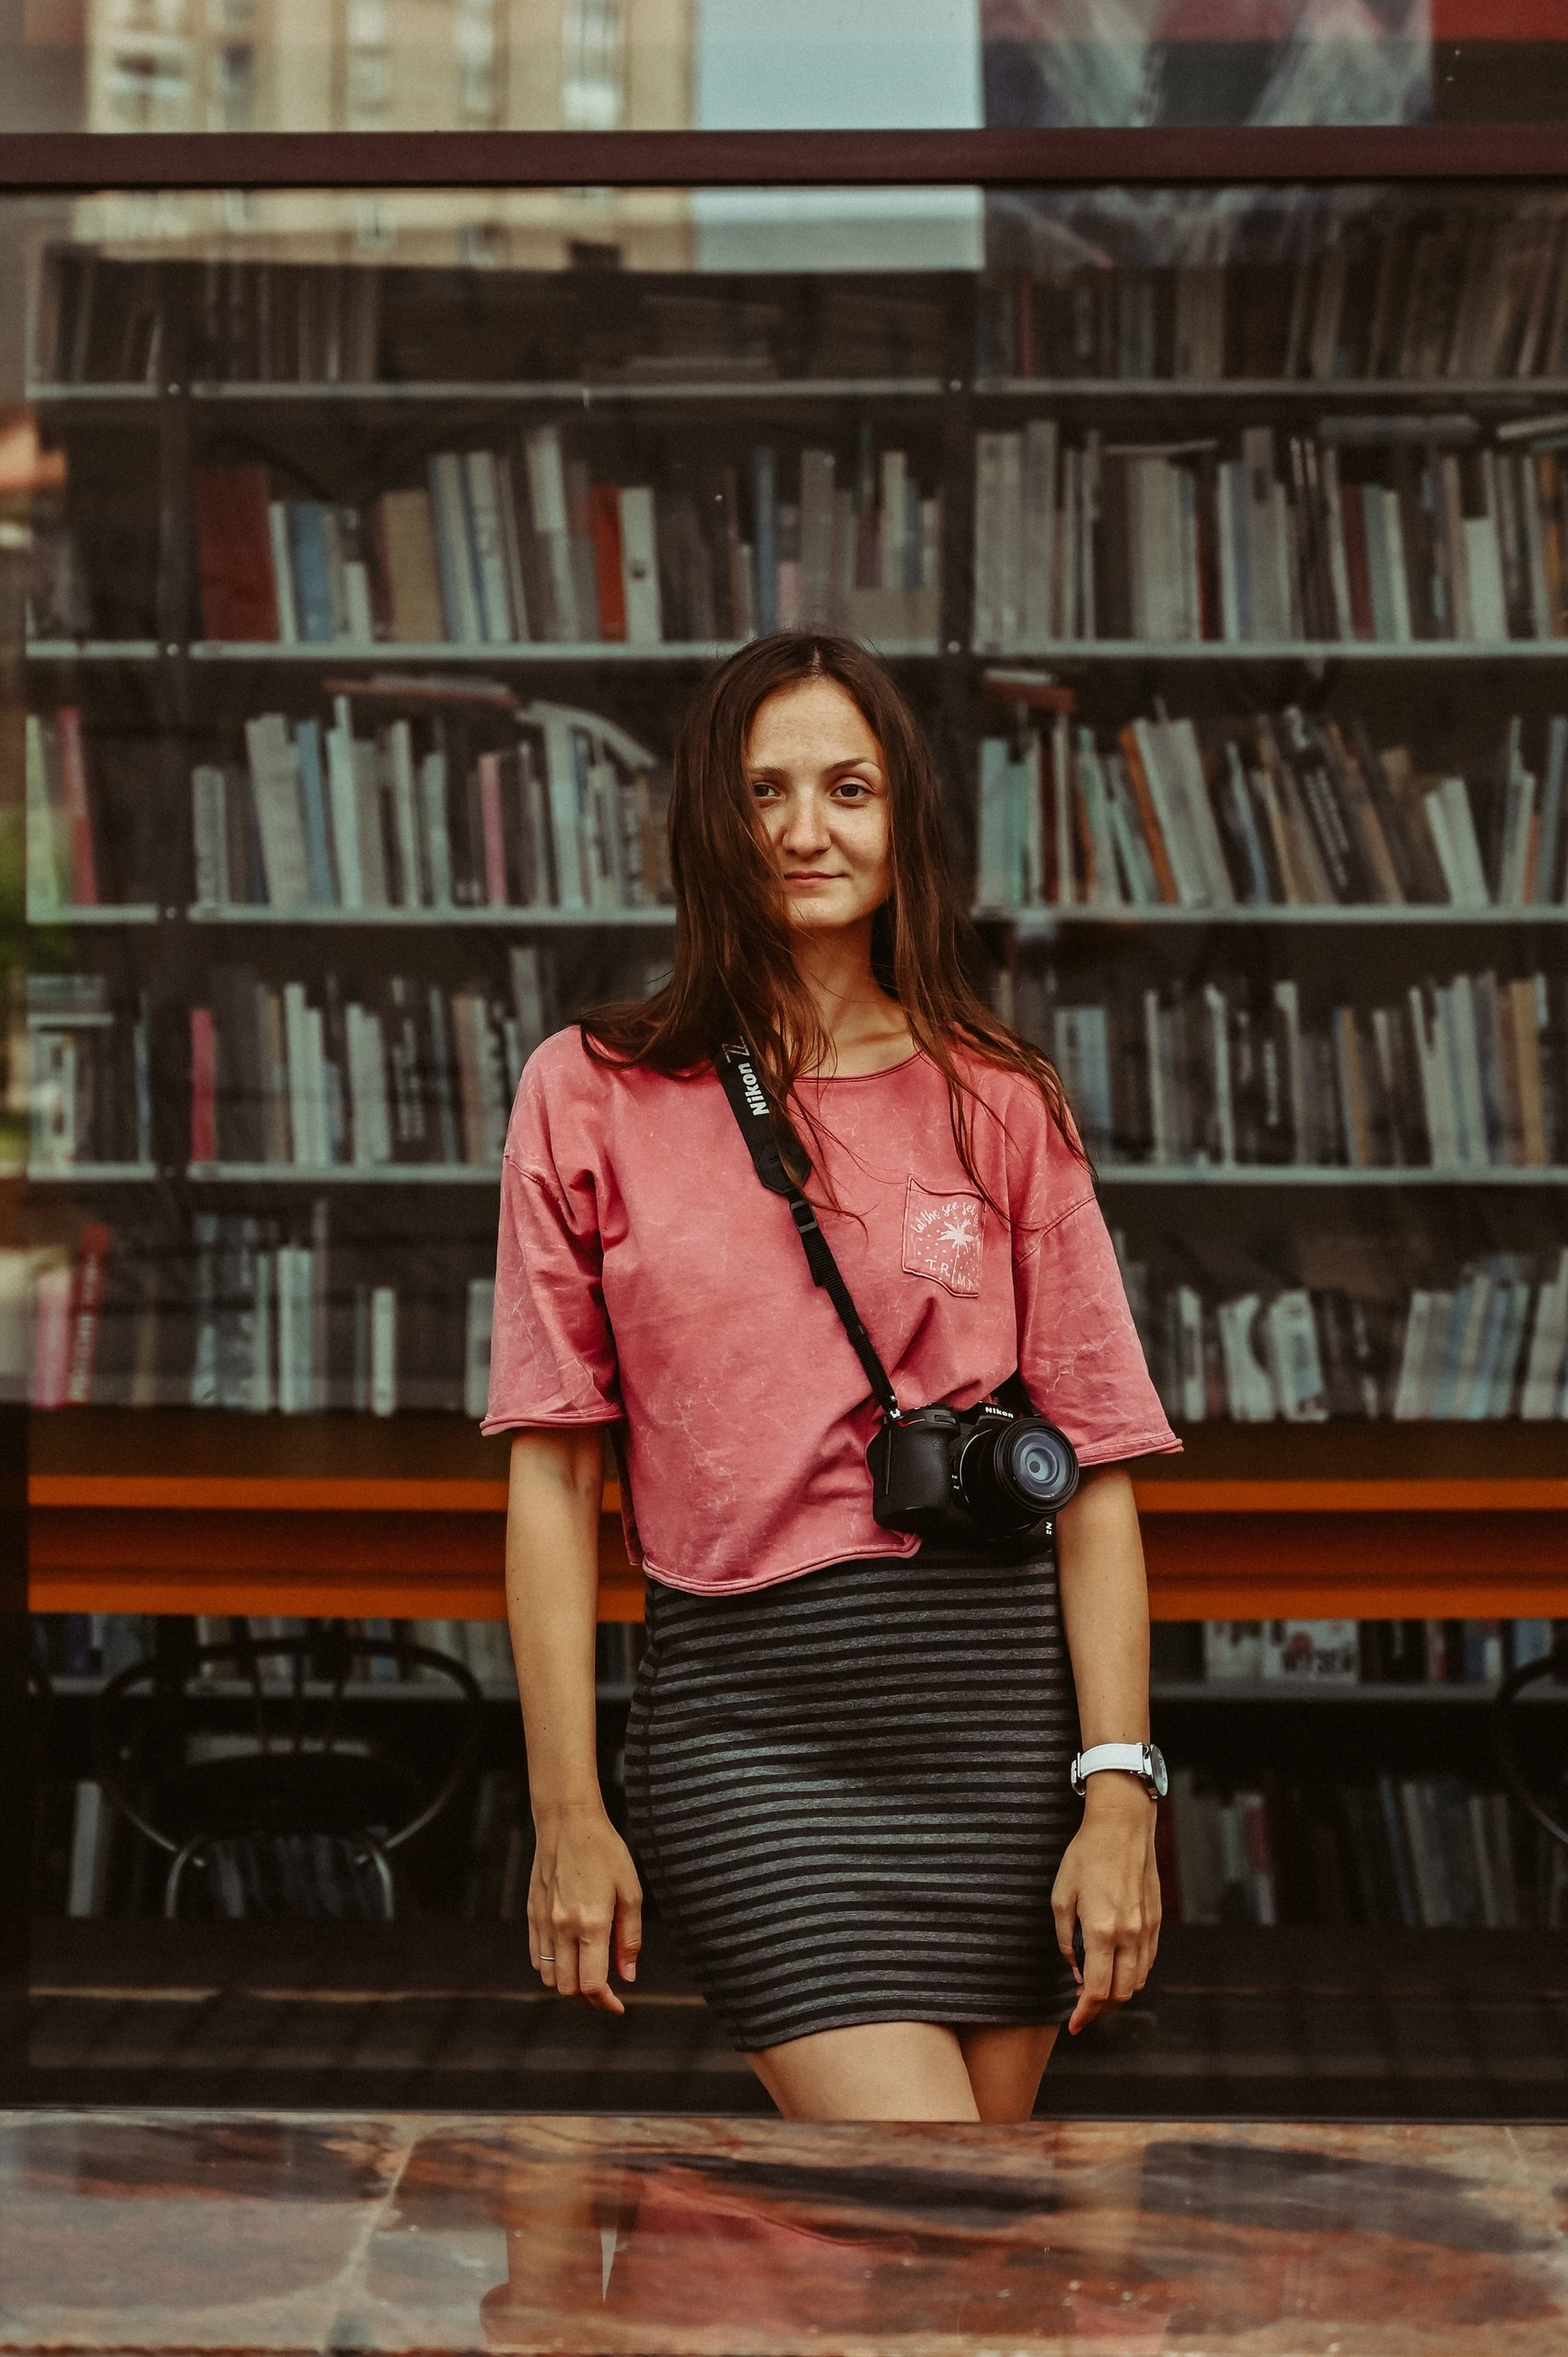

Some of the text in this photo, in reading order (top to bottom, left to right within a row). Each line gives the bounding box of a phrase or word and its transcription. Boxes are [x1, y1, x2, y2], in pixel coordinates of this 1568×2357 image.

[738, 1063, 769, 1115] Nikon
[922, 1210, 940, 1225] the
[985, 1407, 1014, 1418] Nikon
